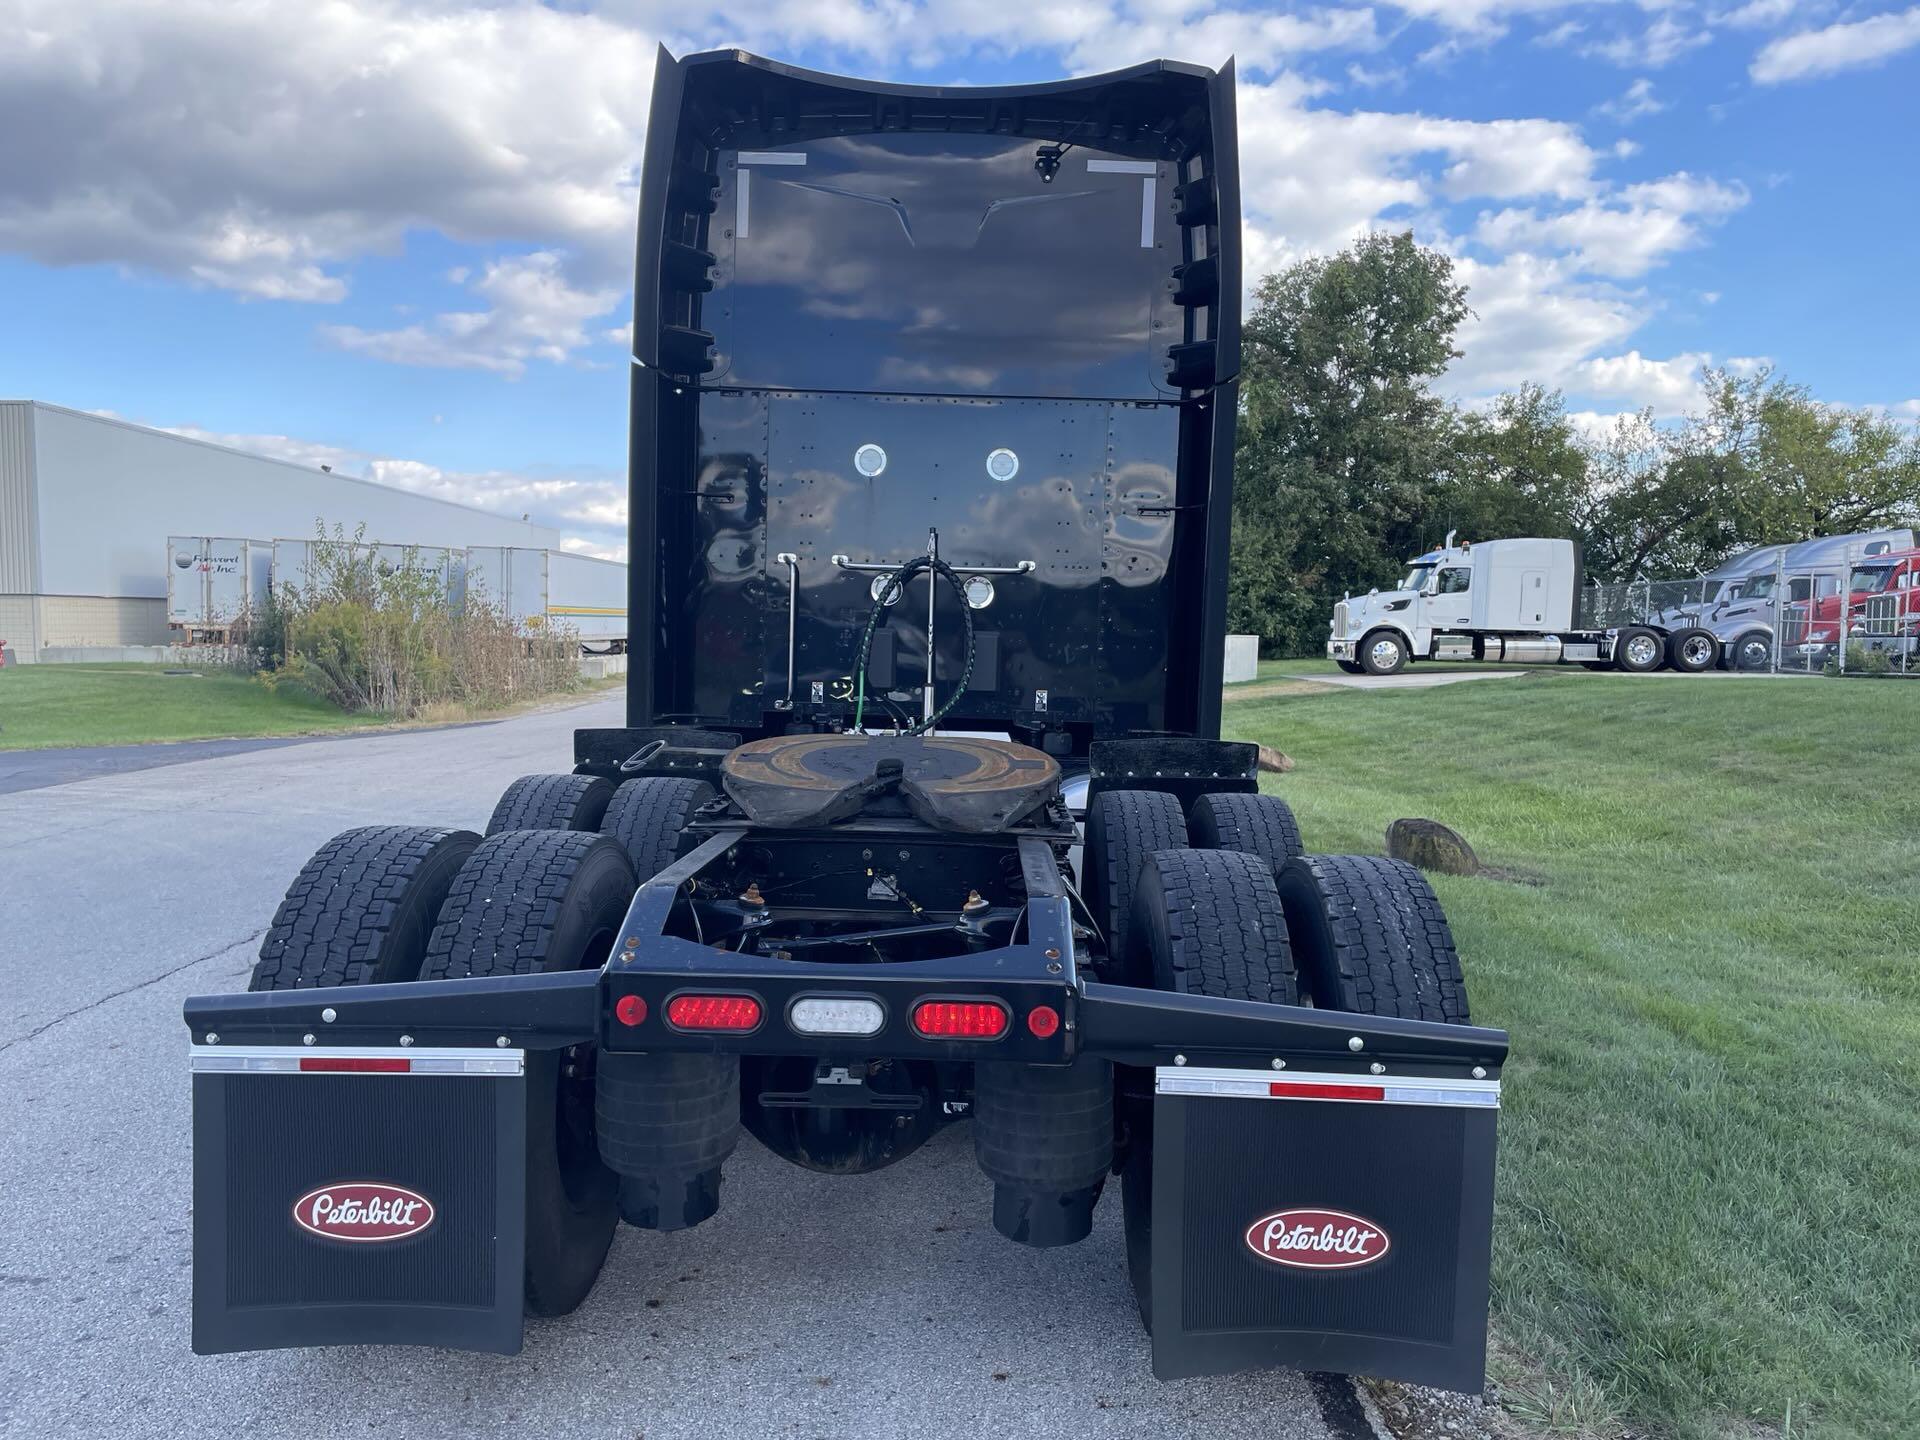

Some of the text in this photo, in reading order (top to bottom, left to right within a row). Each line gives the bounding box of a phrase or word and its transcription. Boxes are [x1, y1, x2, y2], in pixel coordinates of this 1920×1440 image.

[193, 554, 239, 564] Forward
[312, 1194, 423, 1227] Peterbilt
[1263, 1219, 1377, 1255] Peterbilt
